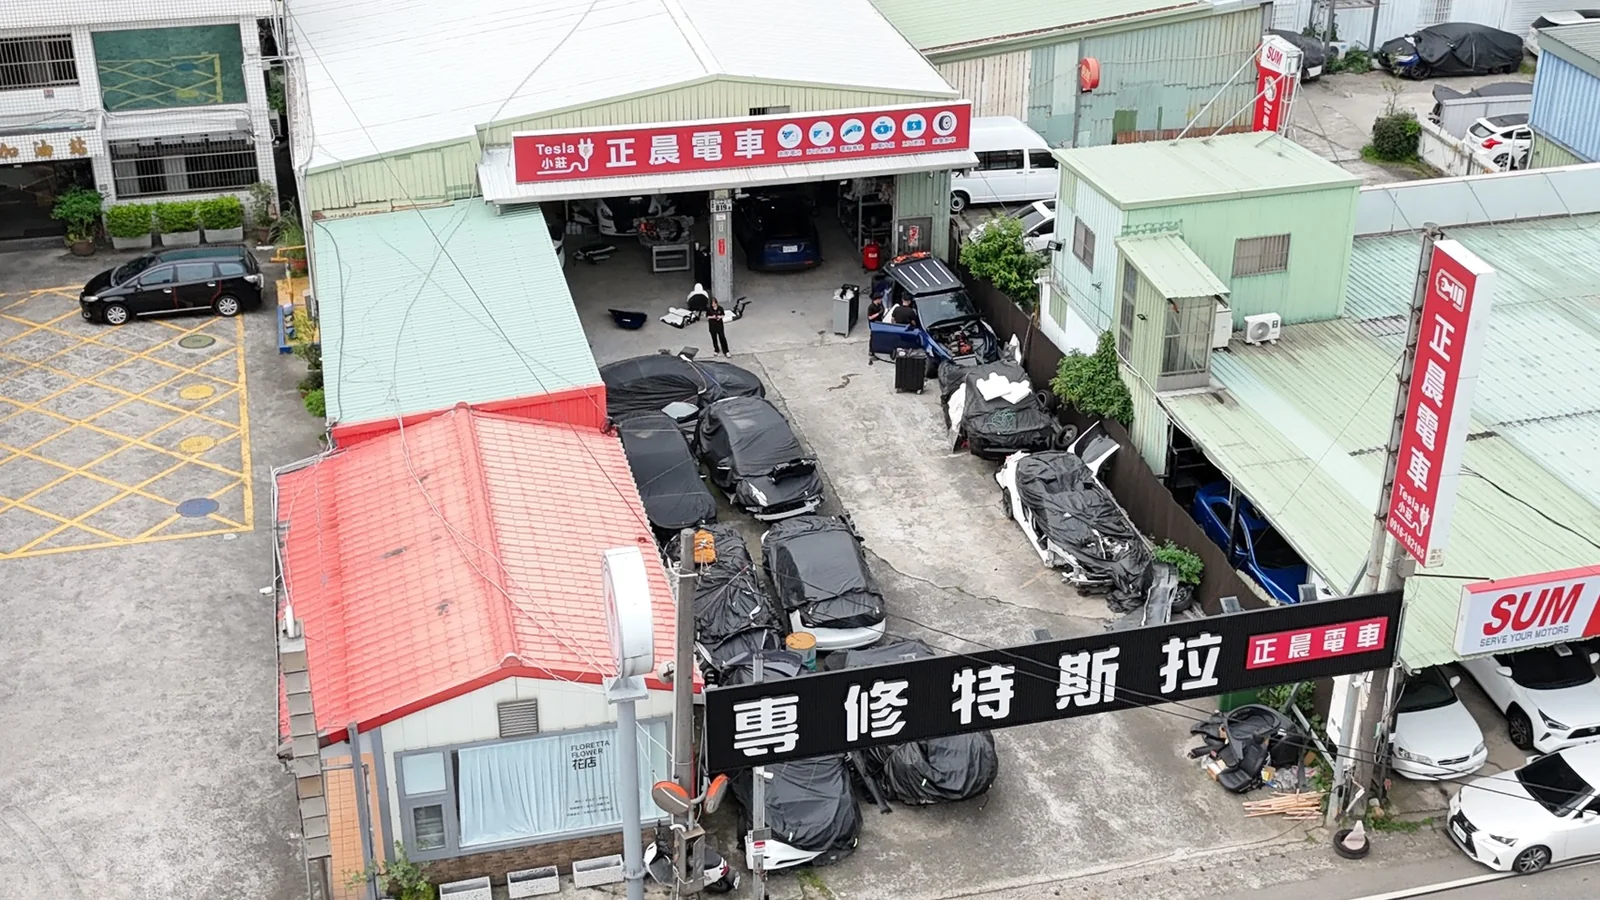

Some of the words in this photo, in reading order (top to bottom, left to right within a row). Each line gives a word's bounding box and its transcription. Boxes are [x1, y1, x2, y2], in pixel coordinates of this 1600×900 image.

[1267, 46, 1283, 65] SUM
[535, 142, 575, 156] Tesla
[606, 128, 765, 168] 正晨電車
[541, 156, 568, 170] 小莊
[1406, 313, 1455, 492] 正晨電車
[1398, 483, 1420, 513] Tesla
[1483, 583, 1585, 636] SUM
[1253, 623, 1381, 664] 正晨電車
[1480, 636, 1507, 647] SERVE
[1511, 631, 1532, 641] YOUR
[1535, 625, 1569, 638] MOTORS
[733, 633, 1223, 757] 專修特斯拉
[570, 740, 610, 751] FLORETTA
[571, 748, 604, 758] FLOWER
[572, 756, 597, 770] 花店
